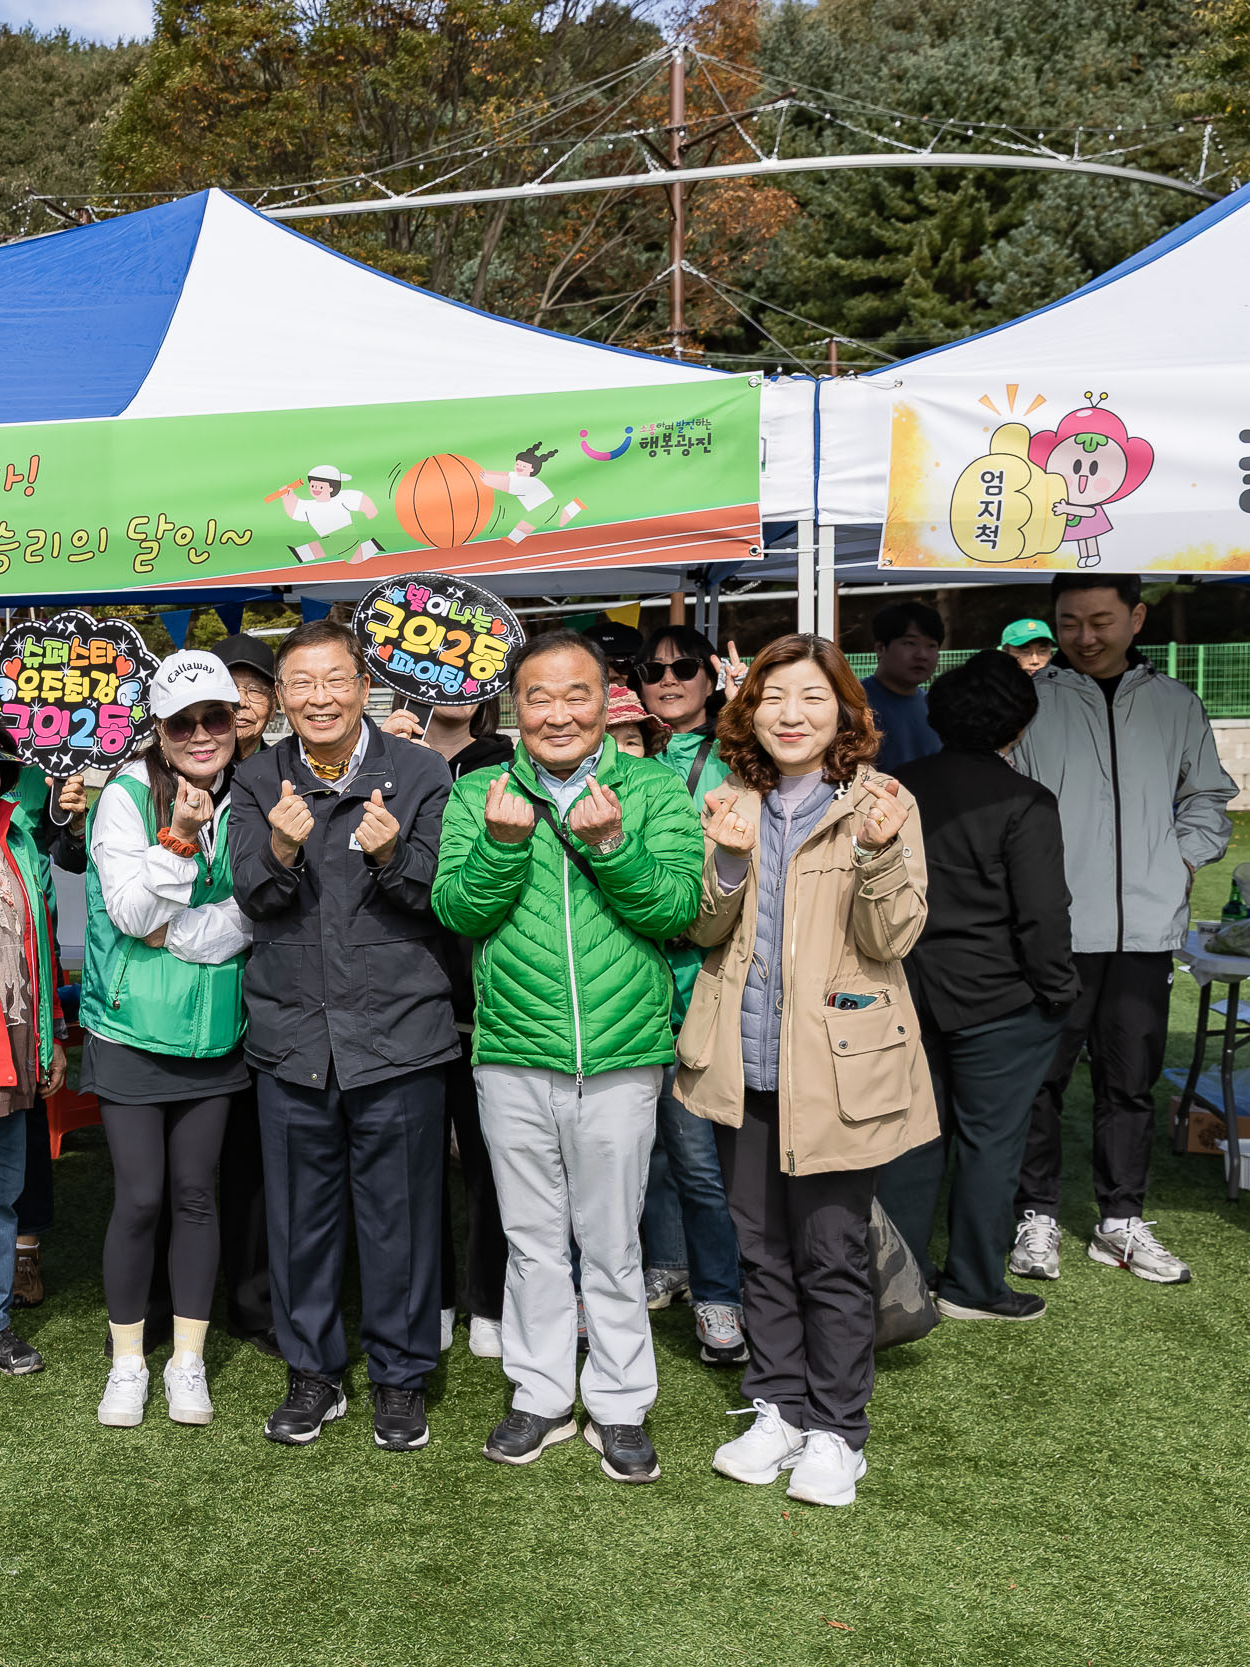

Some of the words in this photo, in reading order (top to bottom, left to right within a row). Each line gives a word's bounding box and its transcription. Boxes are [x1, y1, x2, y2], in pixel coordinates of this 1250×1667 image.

[639, 421, 674, 436] 소통하며
[675, 417, 713, 434] 발전하는
[638, 432, 712, 458] 행복광진
[974, 470, 1004, 550] 엄지척
[22, 636, 118, 669] 슈퍼스타
[366, 598, 510, 681] 구의2동
[16, 668, 120, 704] 우주최강
[167, 662, 215, 684] Callaway
[388, 647, 466, 694] 파이팅
[2, 702, 133, 754] 구의2동
